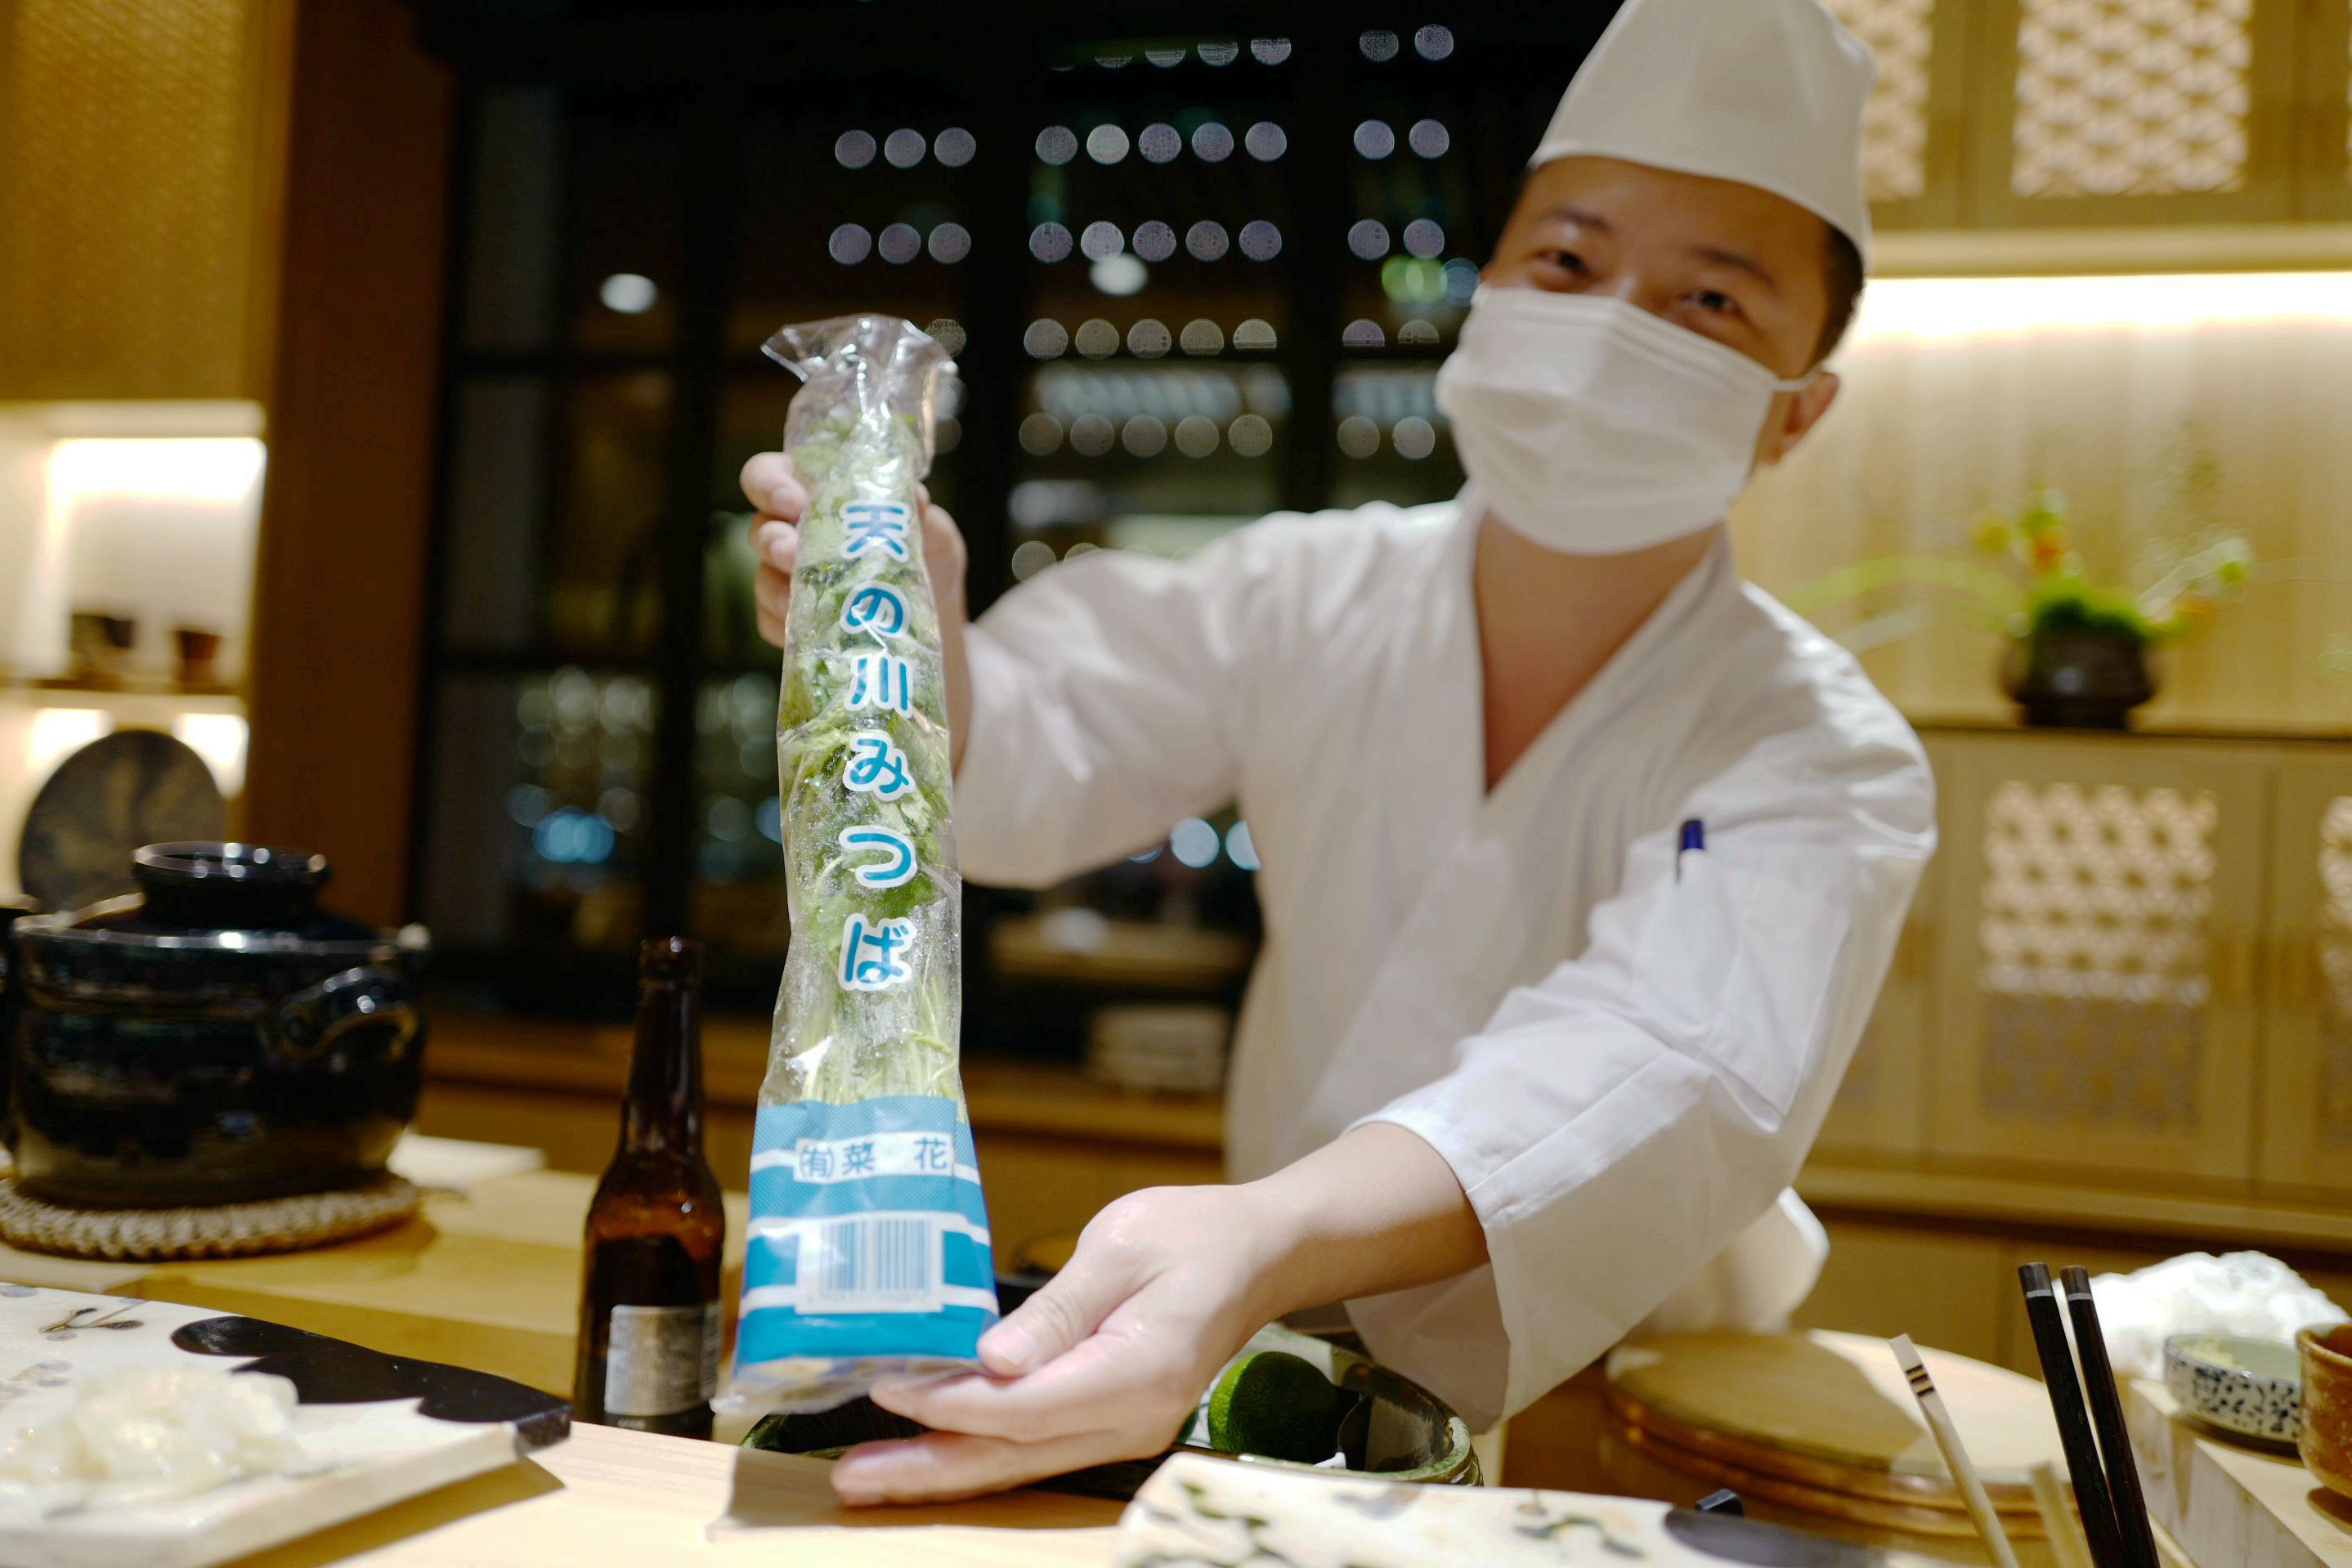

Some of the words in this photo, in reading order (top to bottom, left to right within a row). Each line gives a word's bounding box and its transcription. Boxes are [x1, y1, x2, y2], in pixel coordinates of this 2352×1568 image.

[842, 501, 914, 987] 天の川みつば
